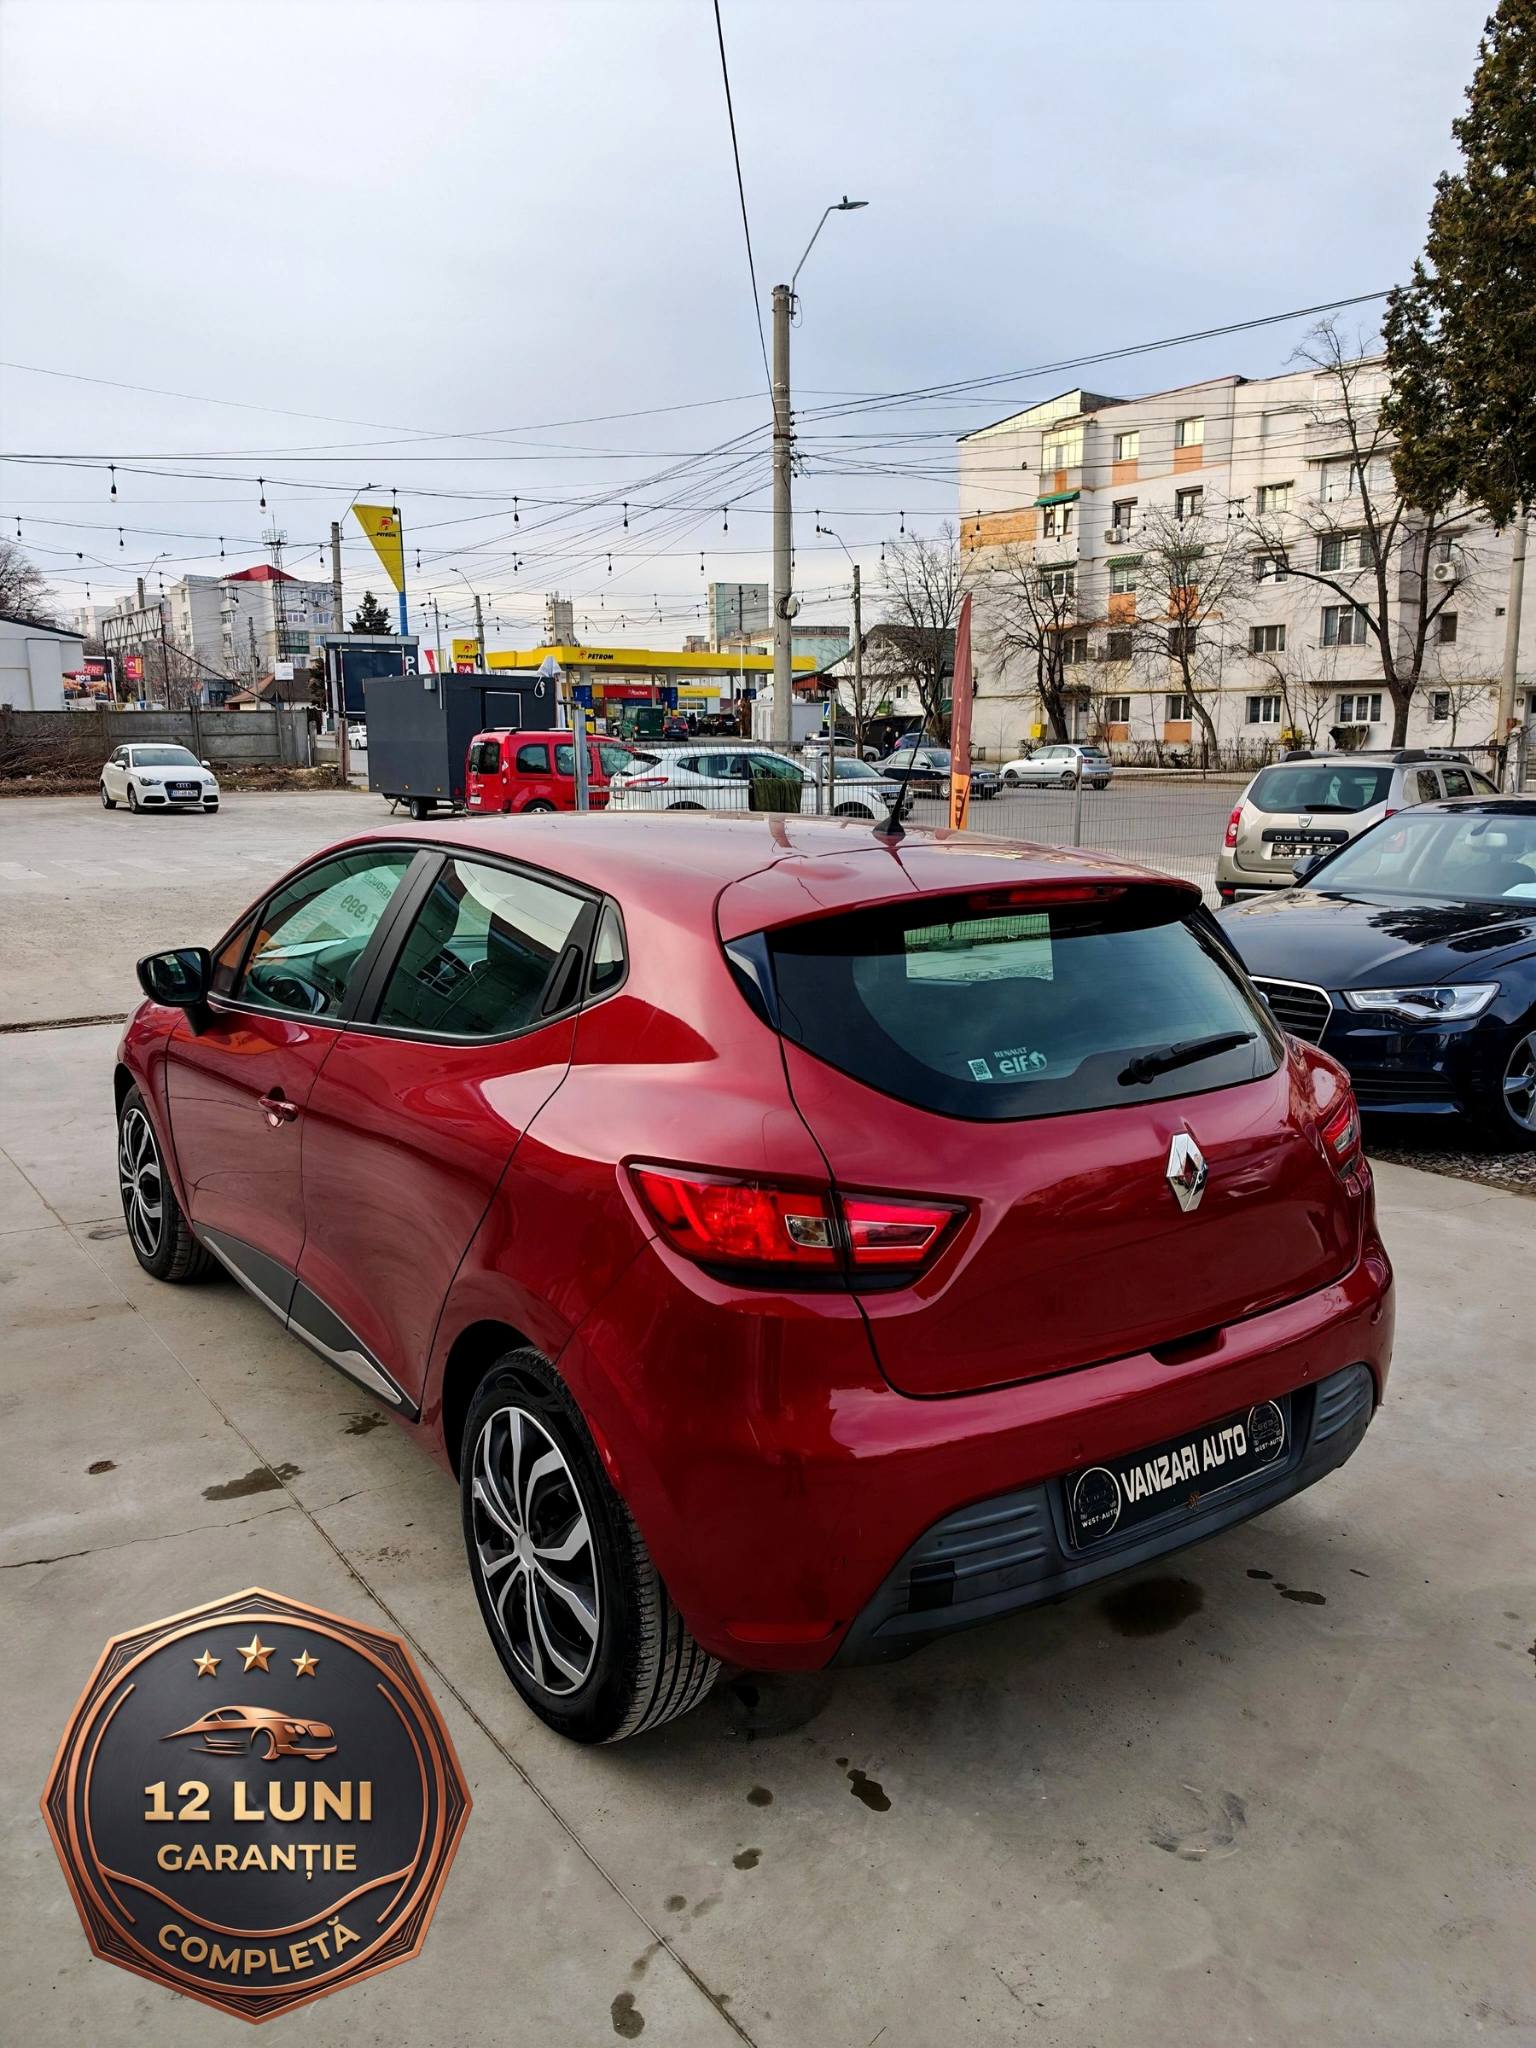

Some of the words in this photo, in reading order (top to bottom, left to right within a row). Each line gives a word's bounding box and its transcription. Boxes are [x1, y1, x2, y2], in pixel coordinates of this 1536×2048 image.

[993, 1047, 1027, 1058] RENAULT
[999, 1055, 1029, 1073] elf
[1120, 1443, 1200, 1503] VANZARI
[1203, 1424, 1247, 1472] AUTO
